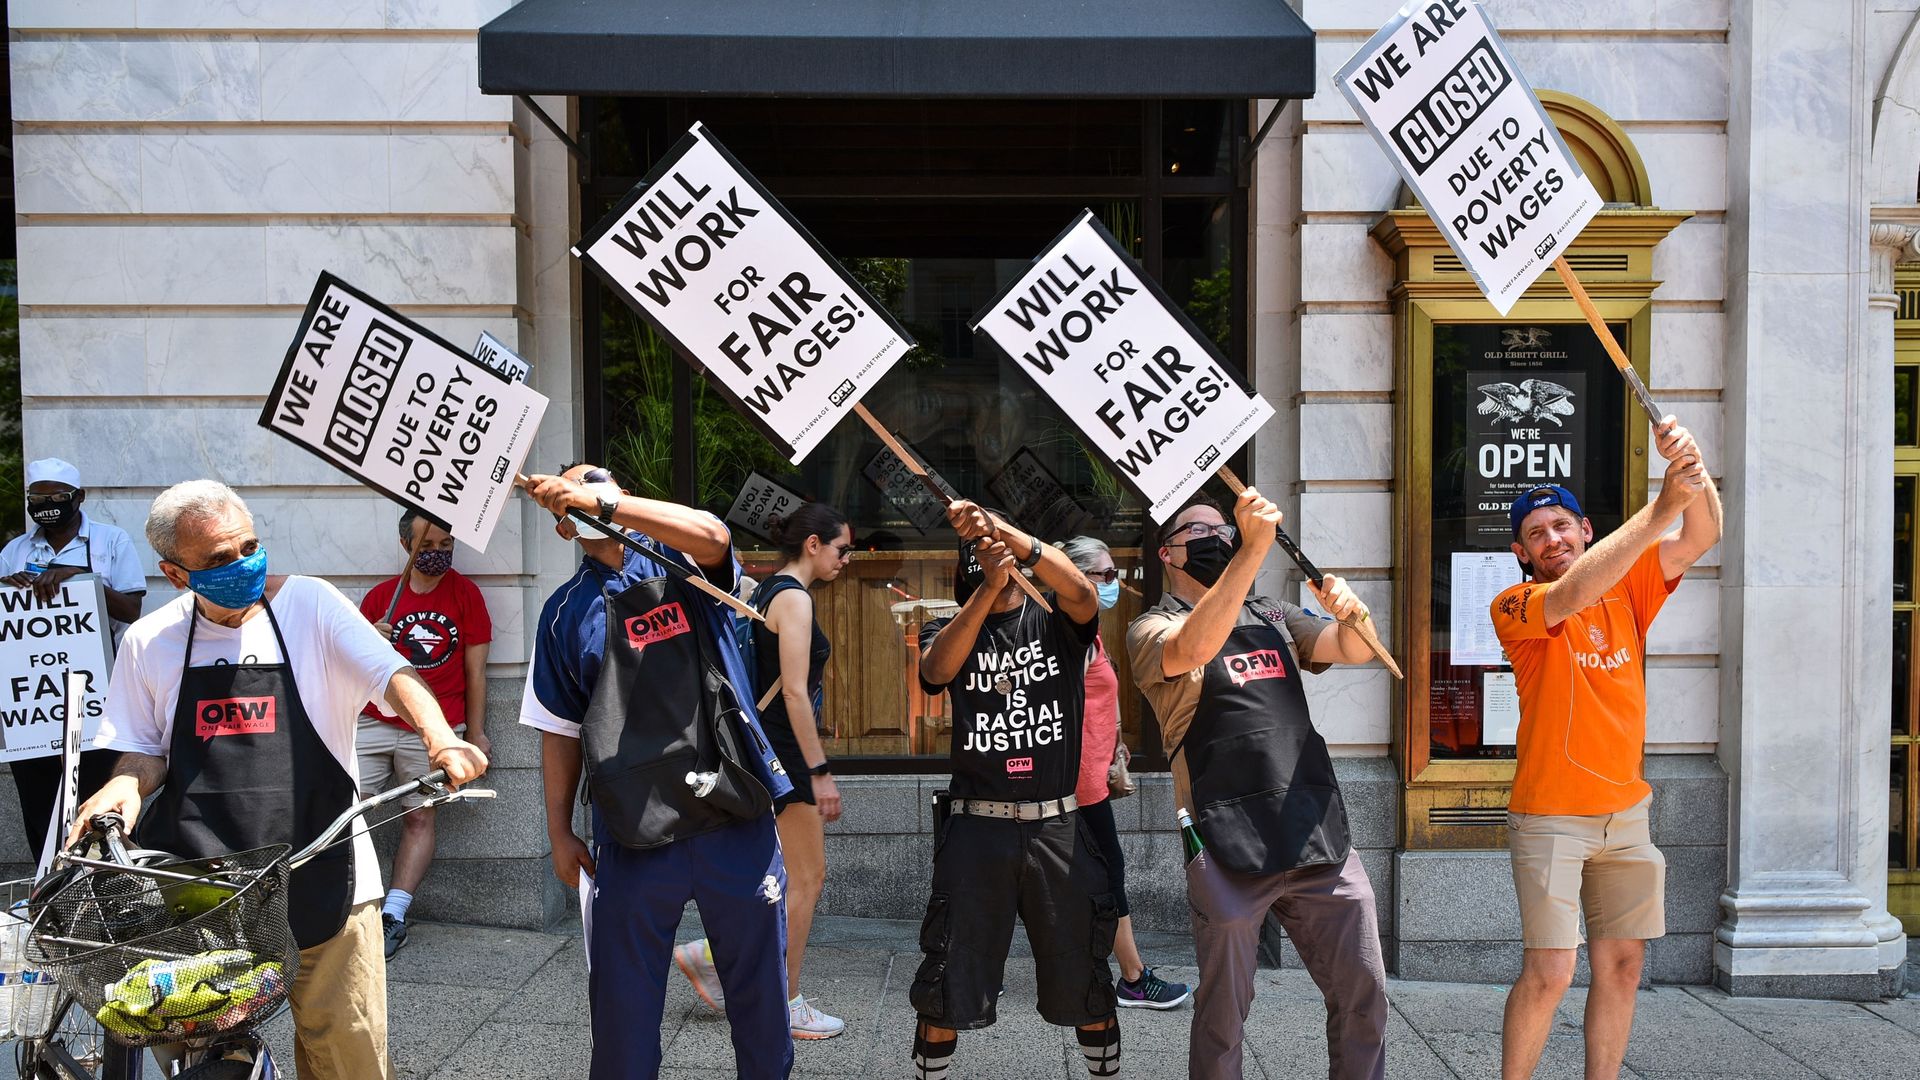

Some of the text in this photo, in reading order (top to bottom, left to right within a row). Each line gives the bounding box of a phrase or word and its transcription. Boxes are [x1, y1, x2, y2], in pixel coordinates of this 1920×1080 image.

[1354, 0, 1467, 104] WE ARE
[1399, 47, 1504, 164] CLOSED
[1448, 117, 1520, 197] DUE TO
[1452, 128, 1550, 241] POVERTY
[610, 171, 711, 260] WILL
[1479, 168, 1564, 260] WAGES
[634, 186, 760, 307] WORK
[1500, 258, 1535, 295] #ONEFAIRWAGE
[1537, 235, 1554, 255] OFW
[713, 265, 765, 315] FOR
[1004, 254, 1096, 332] WILL
[718, 271, 826, 376] FAIR
[1023, 267, 1138, 376] WORK
[279, 295, 350, 427] WE ARE
[477, 342, 524, 381] WE ARE
[743, 293, 865, 415] WAGES!
[1093, 339, 1140, 384] FOR
[330, 328, 405, 457] CLOSED
[386, 372, 436, 466] DUE TO
[791, 337, 898, 446] ONEFAIRWAGE OFW #RAISETHEWAGE
[1095, 345, 1195, 440] FAIR
[1115, 365, 1230, 477] WAGES!
[405, 365, 473, 502] POVERTY
[437, 394, 498, 505] WAGES
[1478, 444, 1571, 478] OPEN
[1511, 428, 1540, 440] WE'RE
[492, 457, 508, 481] OFW
[1155, 470, 1195, 509] #ONEFAIRWAGE
[1197, 447, 1217, 468] OFW
[1478, 502, 1499, 510] OLD
[0, 612, 96, 642] WORK
[392, 612, 447, 645] MPOWER
[631, 607, 679, 635] OFW
[1520, 588, 1531, 623] DRAKO
[29, 652, 69, 668] FOR
[978, 640, 1044, 671] WAGE
[1230, 653, 1278, 673] OFW
[202, 702, 268, 724] OFW
[976, 700, 1063, 731] RACIAL
[1006, 689, 1027, 710] IS
[963, 721, 1063, 752] JUSTICE
[1008, 760, 1030, 768] OFW
